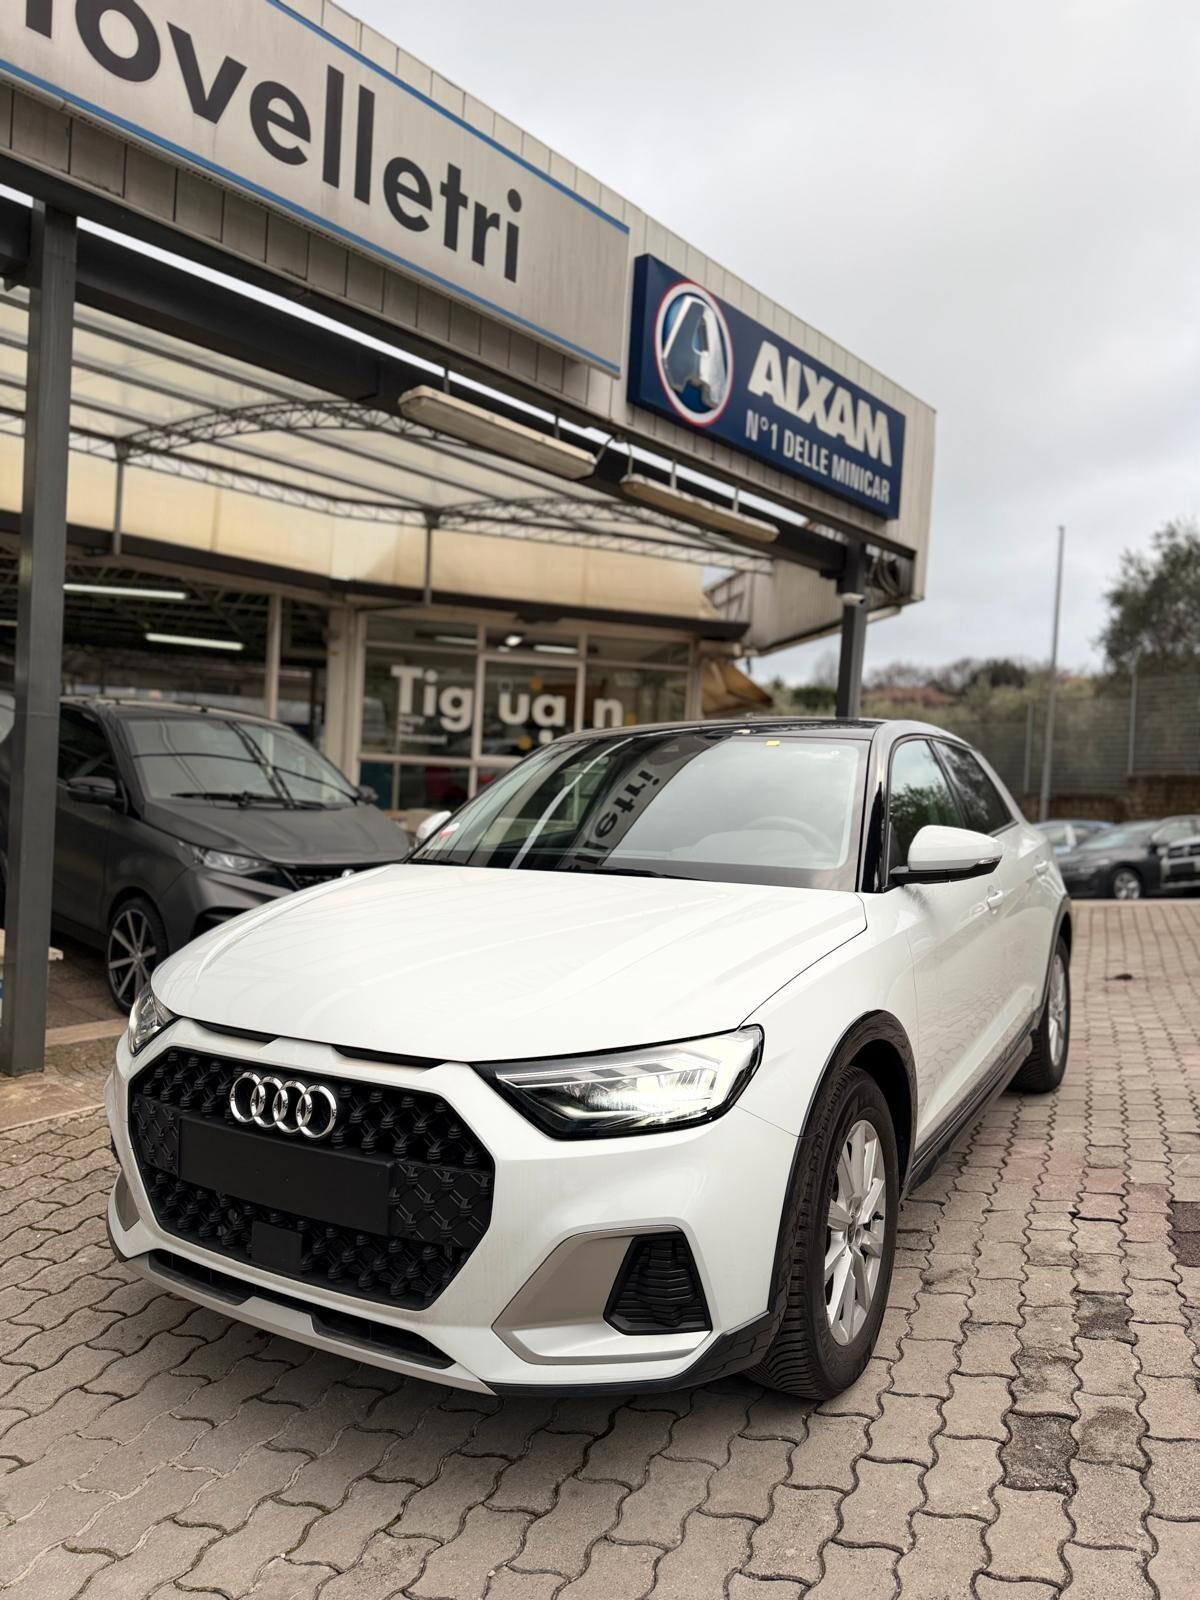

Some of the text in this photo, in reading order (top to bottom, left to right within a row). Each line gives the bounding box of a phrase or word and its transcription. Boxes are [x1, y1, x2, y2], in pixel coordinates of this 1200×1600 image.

[748, 341, 892, 467] AIXAM
[783, 429, 829, 476] DELLE
[831, 453, 890, 505] MINICAR
